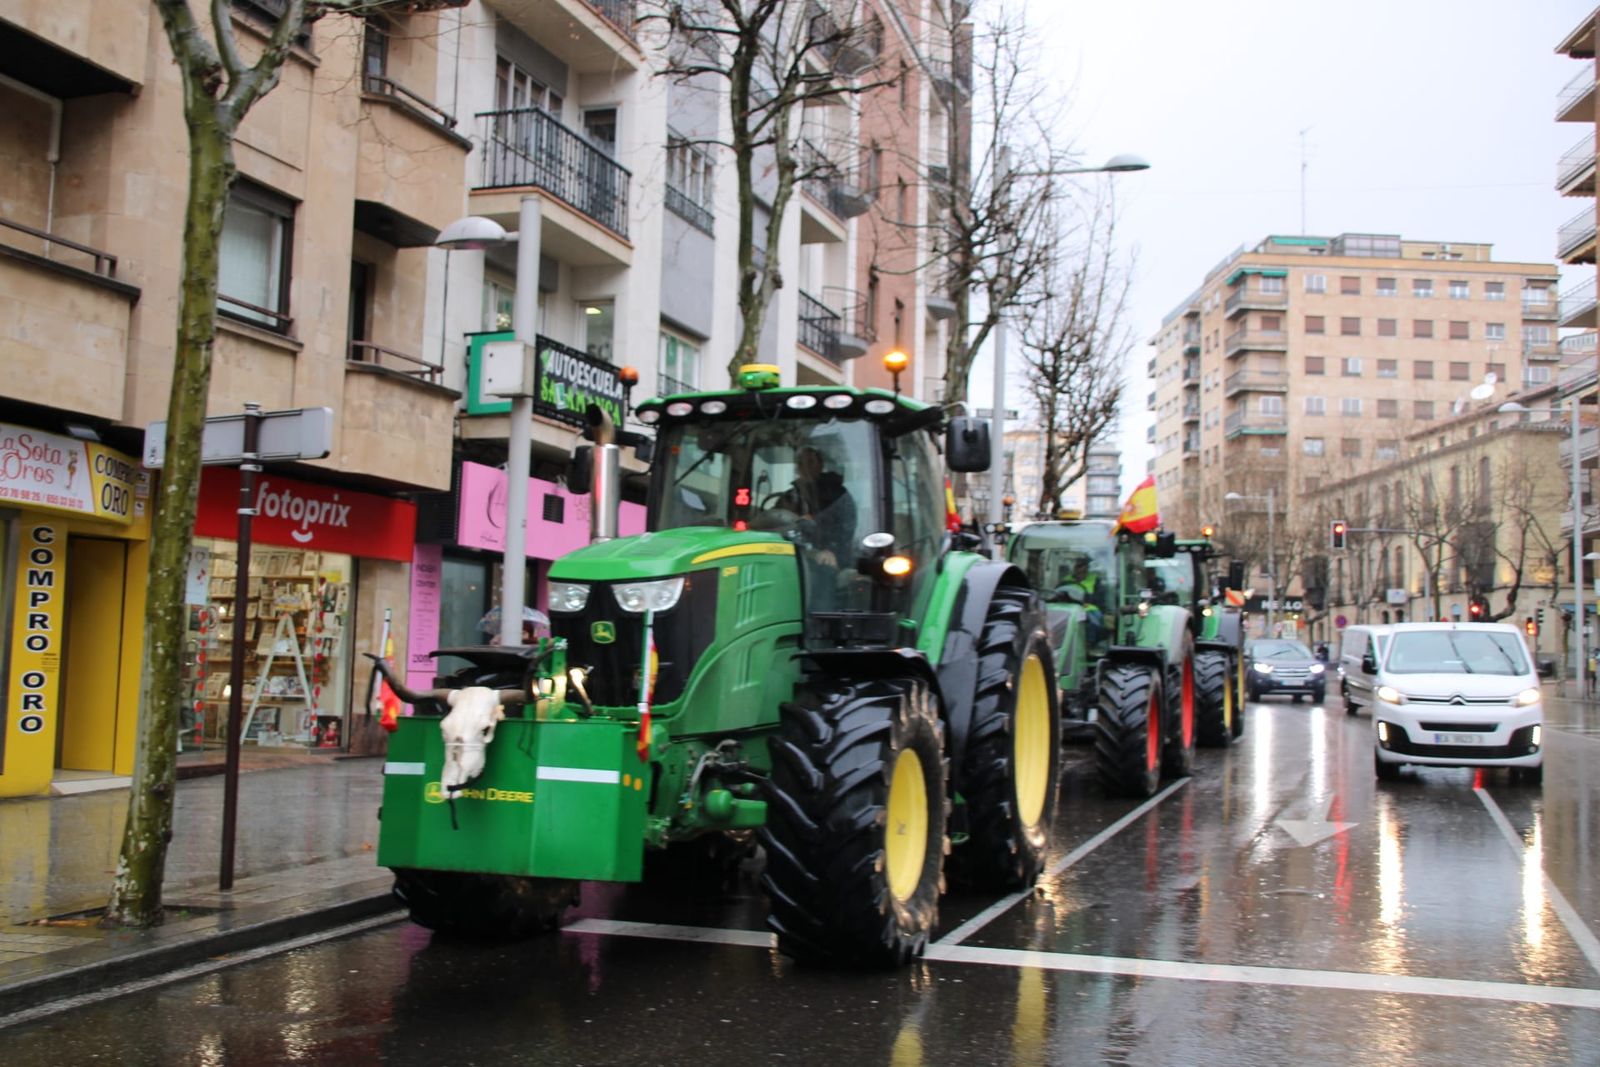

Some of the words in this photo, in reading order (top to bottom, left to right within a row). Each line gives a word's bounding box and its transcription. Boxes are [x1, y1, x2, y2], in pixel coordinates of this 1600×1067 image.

[547, 349, 623, 400] AUTOESCUELA
[17, 433, 63, 466] Sota
[3, 450, 55, 485] Oros
[101, 482, 129, 516] ORO
[256, 481, 351, 530] fotoprix
[25, 525, 55, 652] COMPRO
[1261, 600, 1303, 610] HELO
[19, 671, 46, 734] ORO
[486, 787, 535, 803] DEERE
